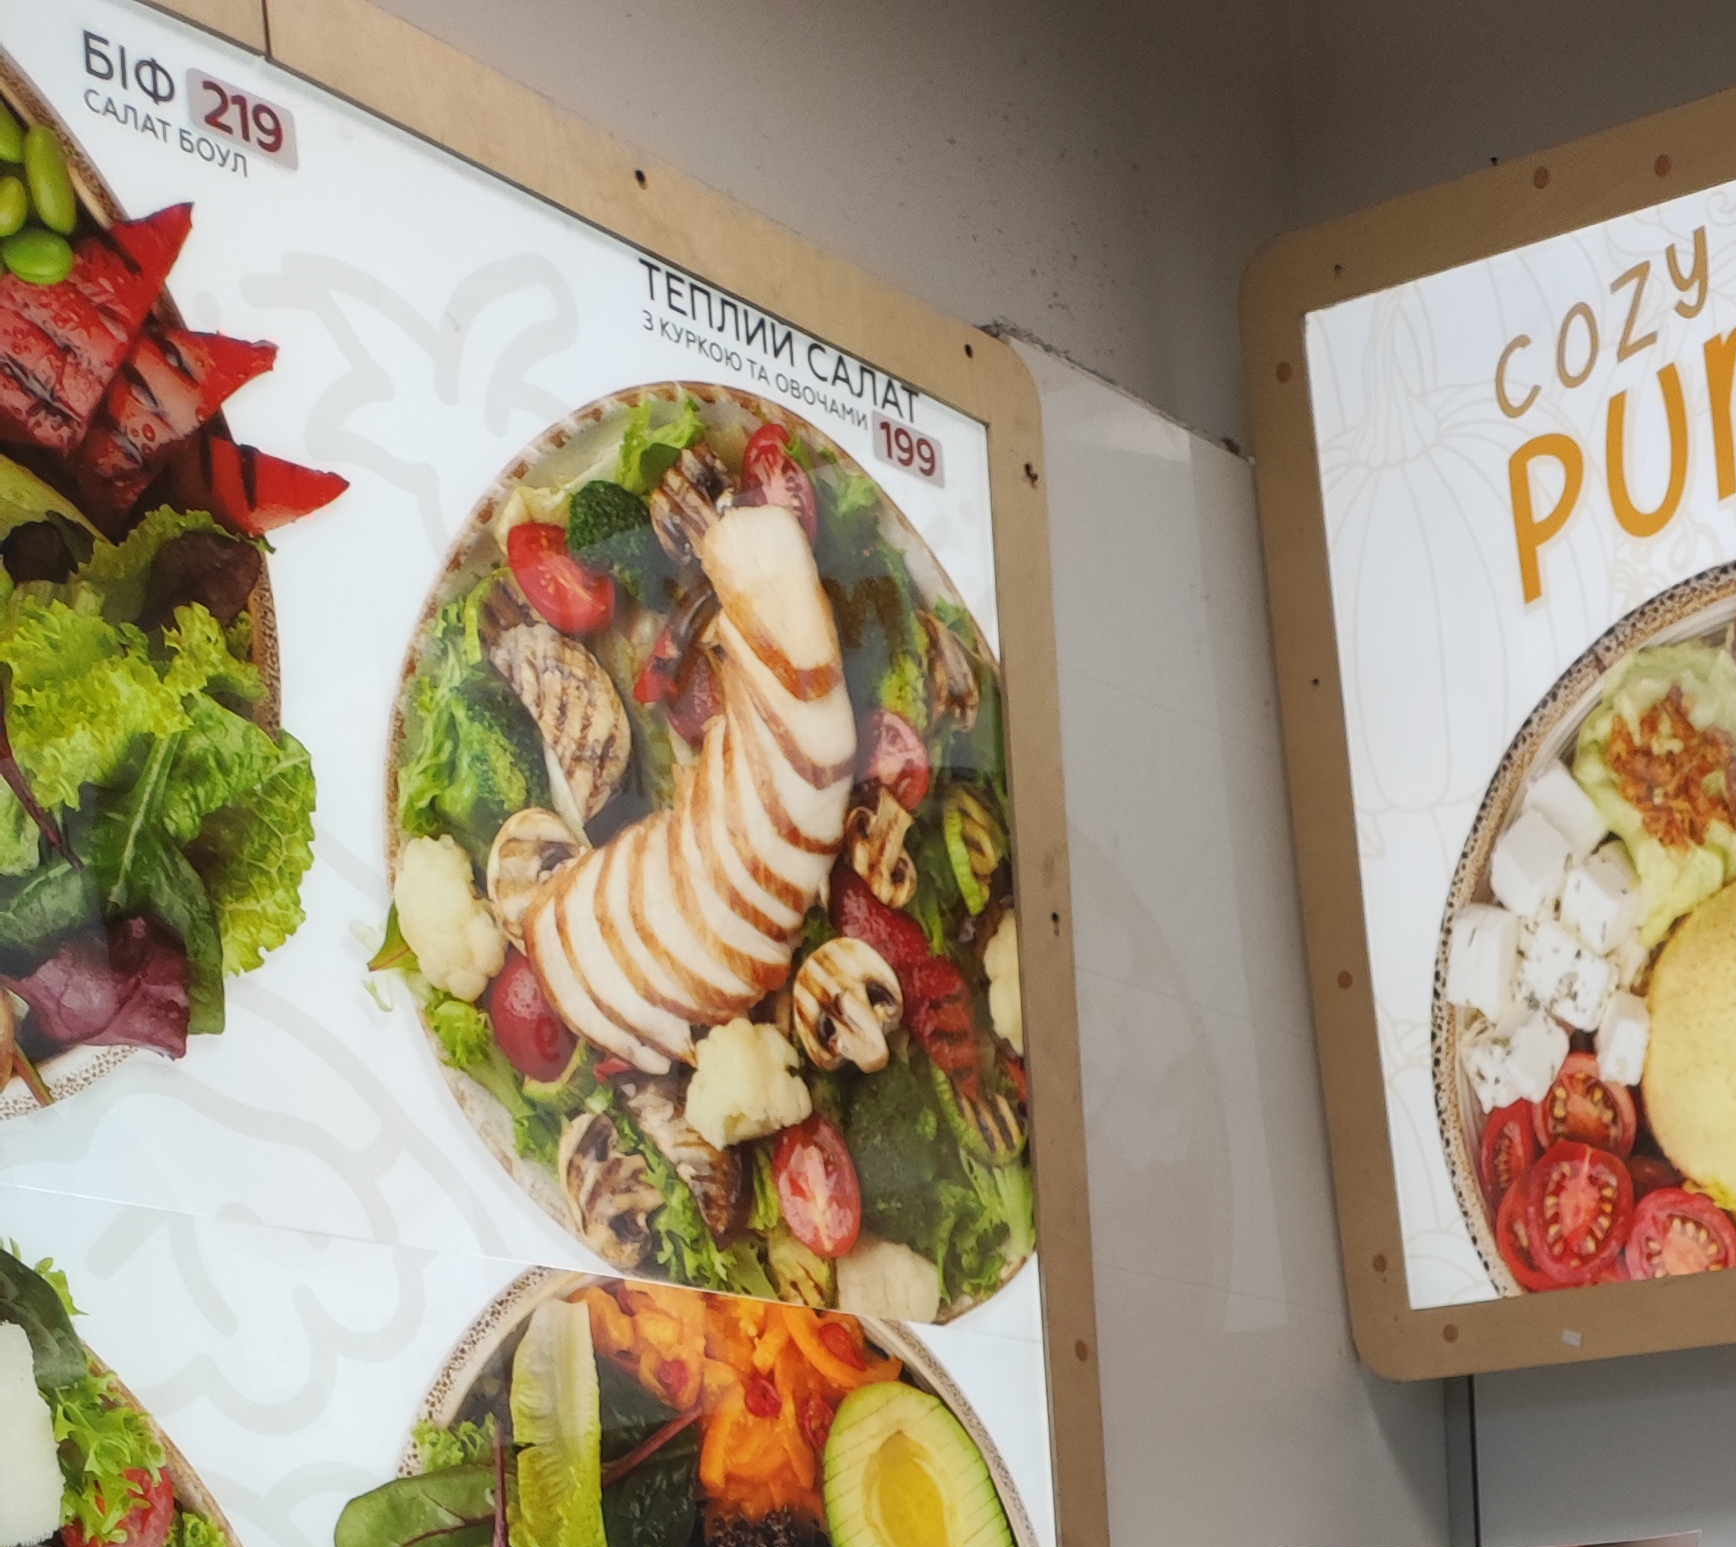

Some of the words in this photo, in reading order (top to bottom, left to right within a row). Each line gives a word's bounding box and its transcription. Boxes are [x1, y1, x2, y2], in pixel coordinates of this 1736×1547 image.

[83, 29, 175, 105] БІФ
[202, 80, 283, 153] 219
[83, 88, 172, 143] САЛАТ
[178, 128, 248, 178] БОУЛ
[642, 309, 654, 331] З
[660, 316, 742, 372] КУРКОЮ
[746, 358, 771, 386] ТА
[775, 373, 869, 431] ОВОЧАМИ
[807, 342, 920, 423] САЛАТ
[879, 421, 936, 476] 199
